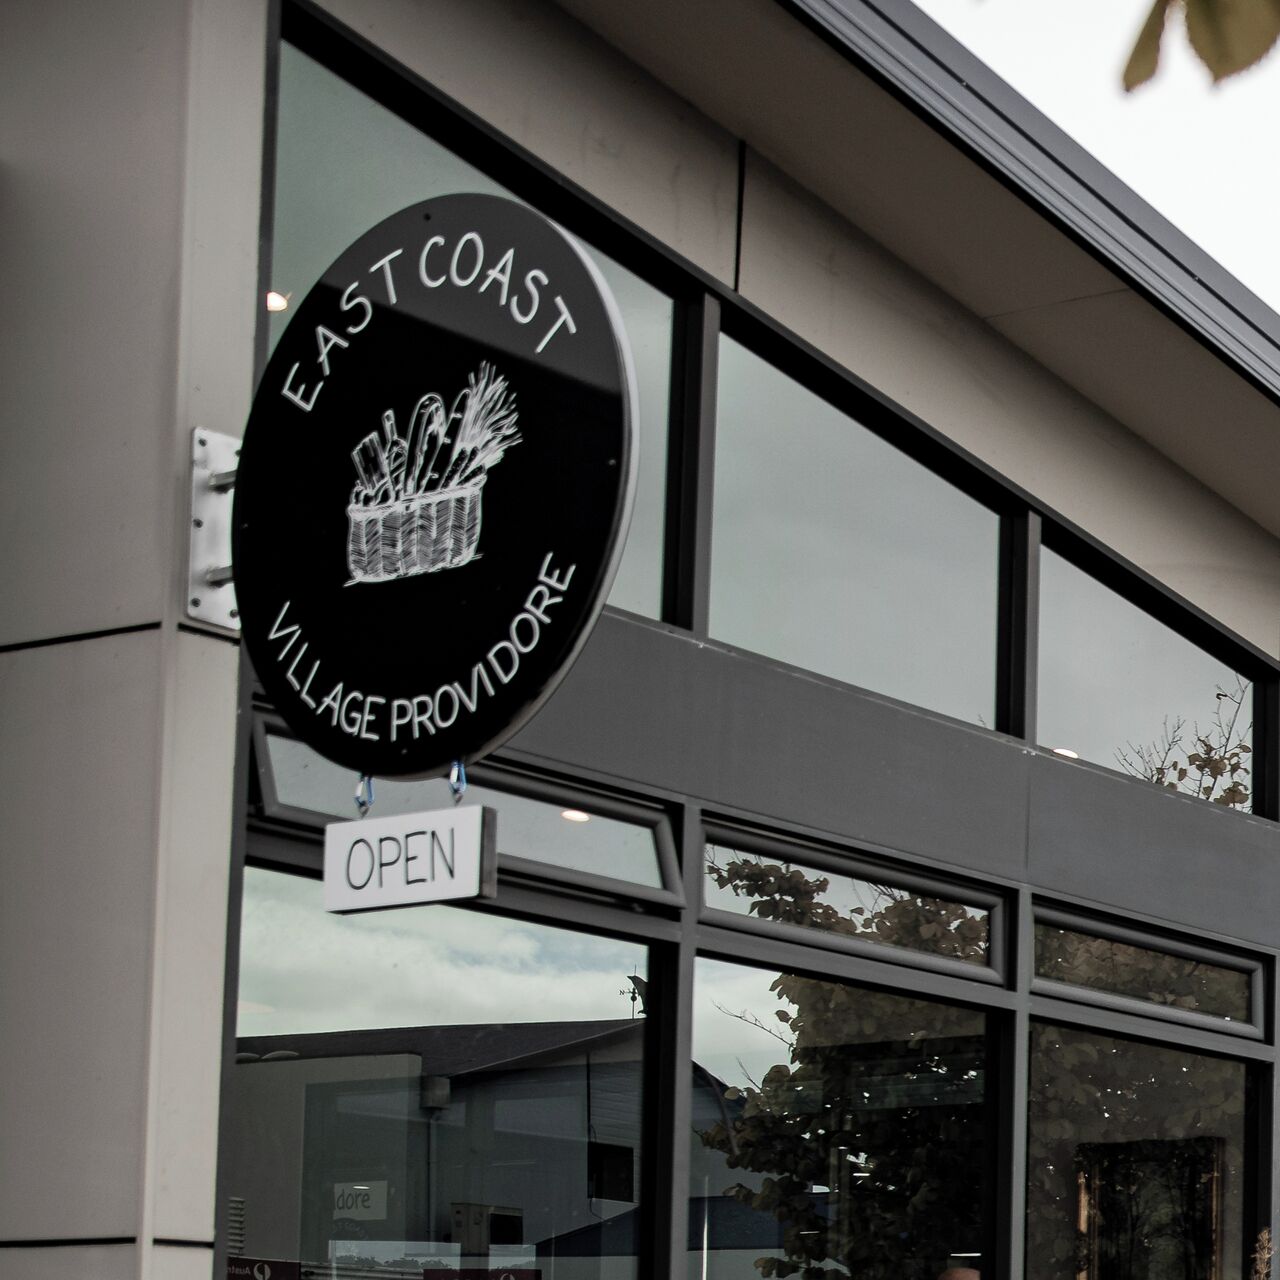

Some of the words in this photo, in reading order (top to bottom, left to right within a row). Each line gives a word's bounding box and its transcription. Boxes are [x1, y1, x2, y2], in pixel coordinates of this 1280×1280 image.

[281, 248, 404, 412] EAST
[418, 231, 577, 354] COAST
[267, 600, 386, 741] VILLAGE
[390, 552, 577, 742] PROVIDORE
[346, 827, 455, 891] OPEN
